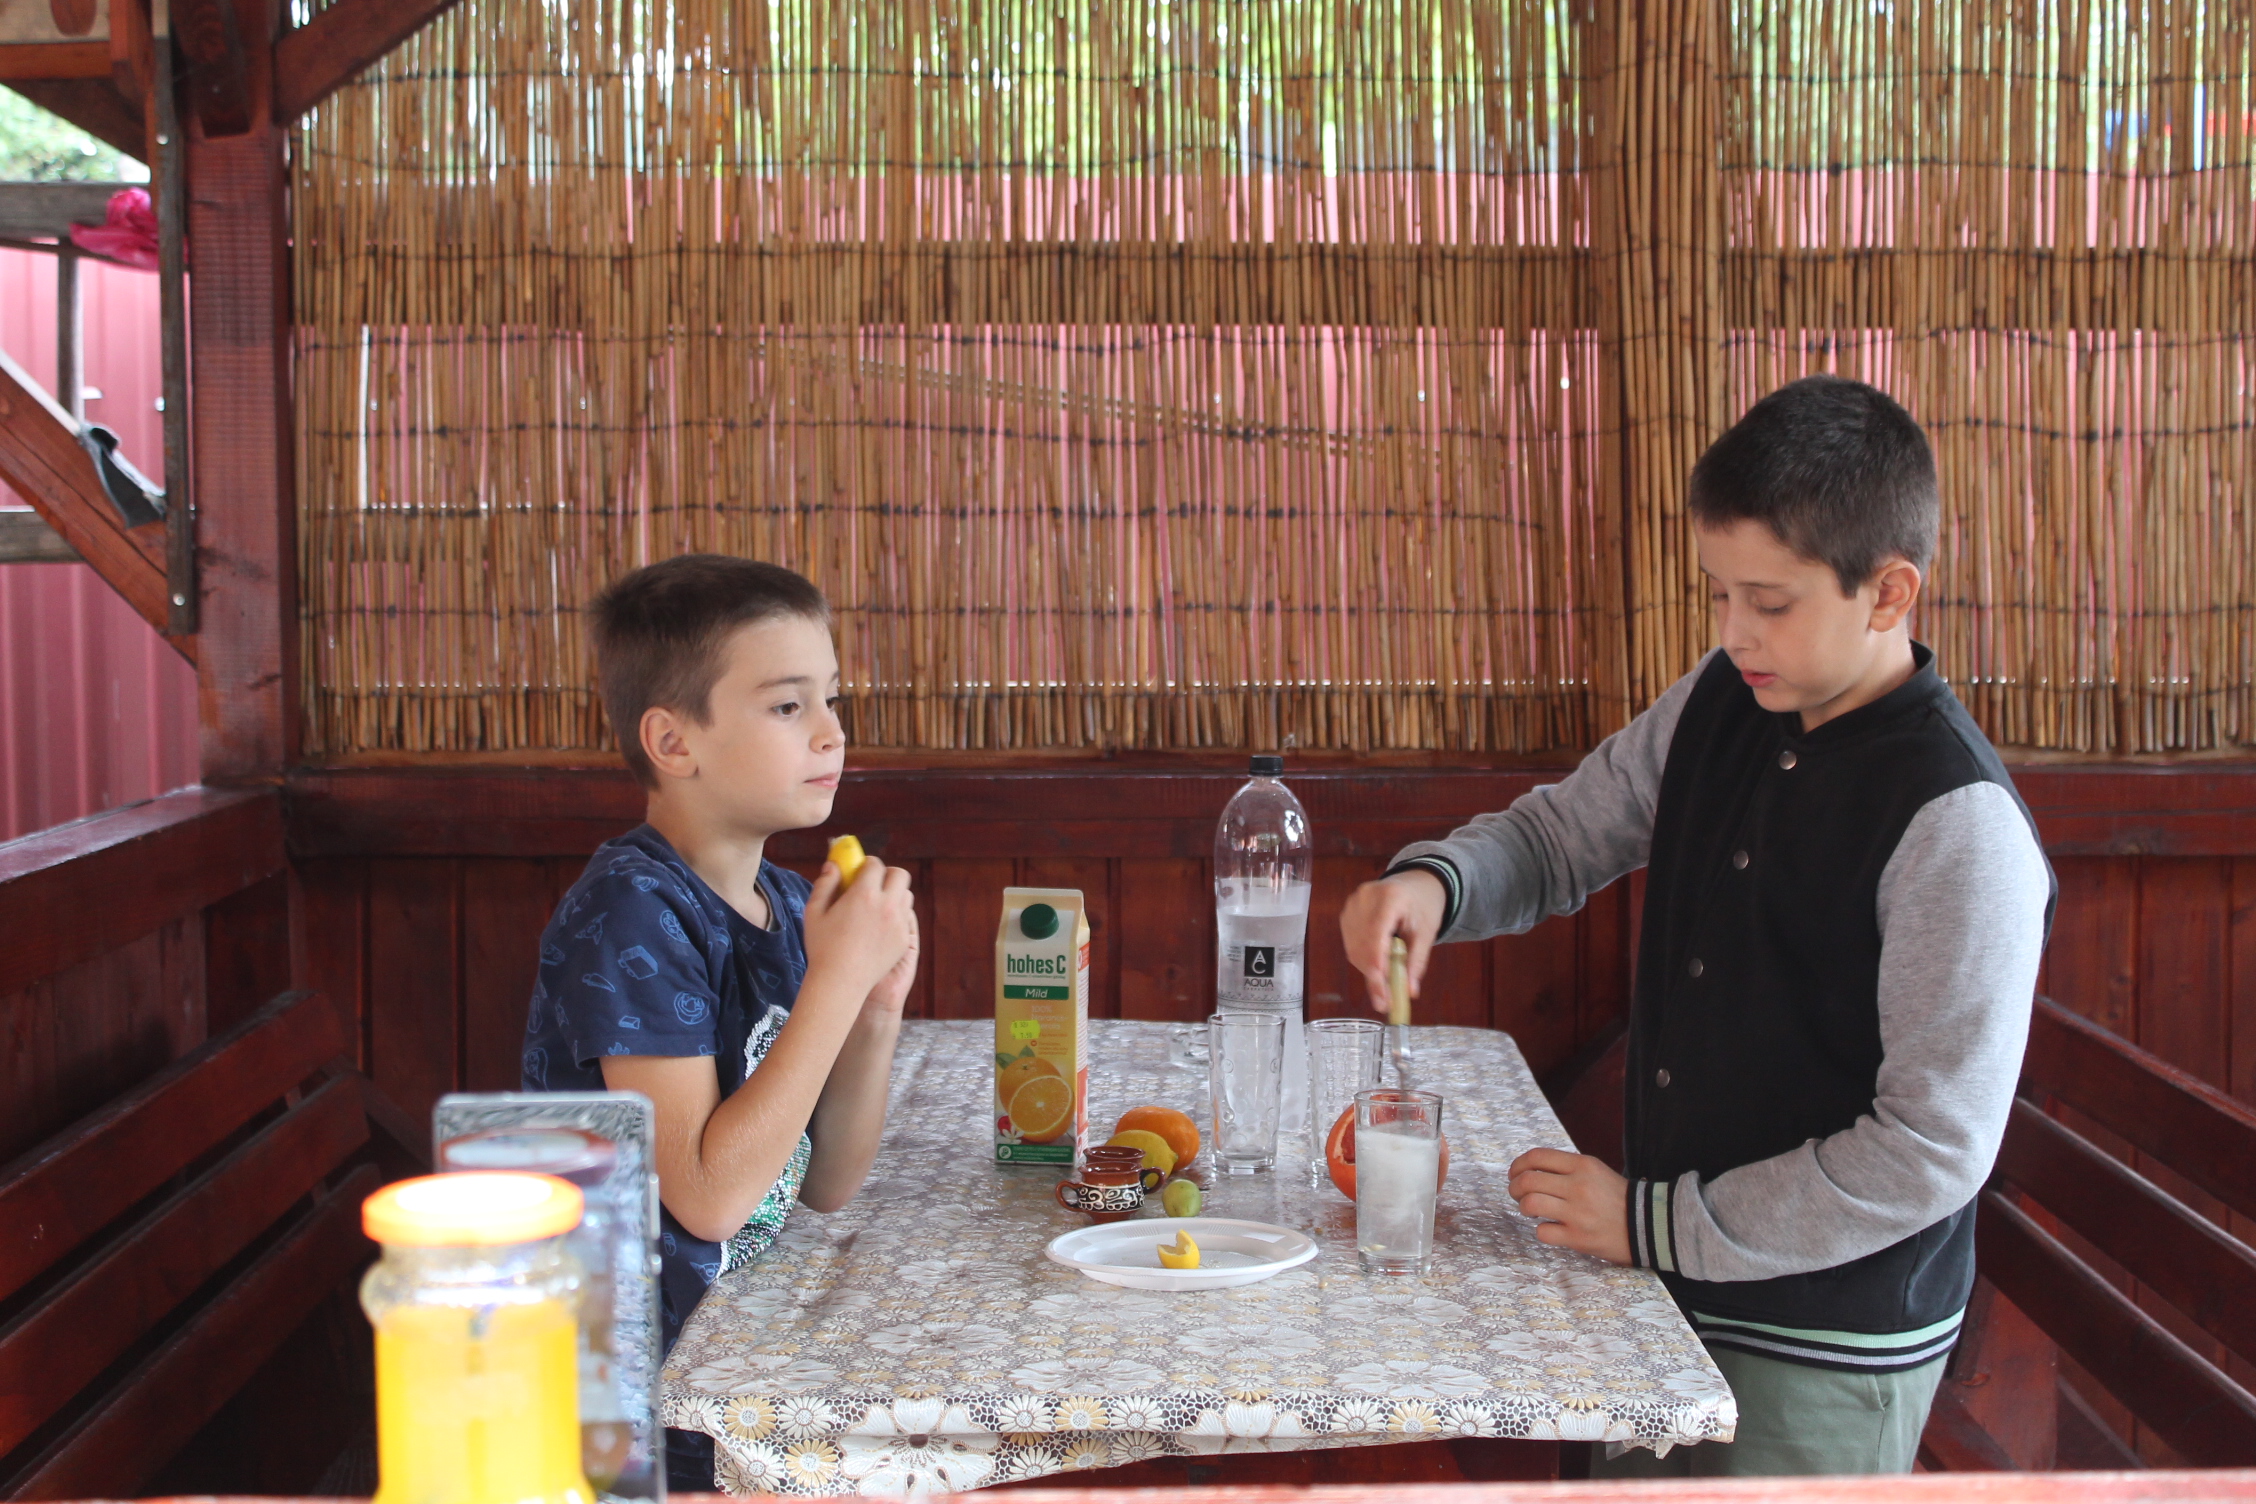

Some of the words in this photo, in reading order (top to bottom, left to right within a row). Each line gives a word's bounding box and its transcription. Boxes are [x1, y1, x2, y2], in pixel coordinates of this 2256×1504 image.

[1007, 953, 1054, 974] hohes
[1056, 954, 1066, 974] C
[1244, 978, 1274, 987] AQUA
[1025, 988, 1048, 998] Mild
